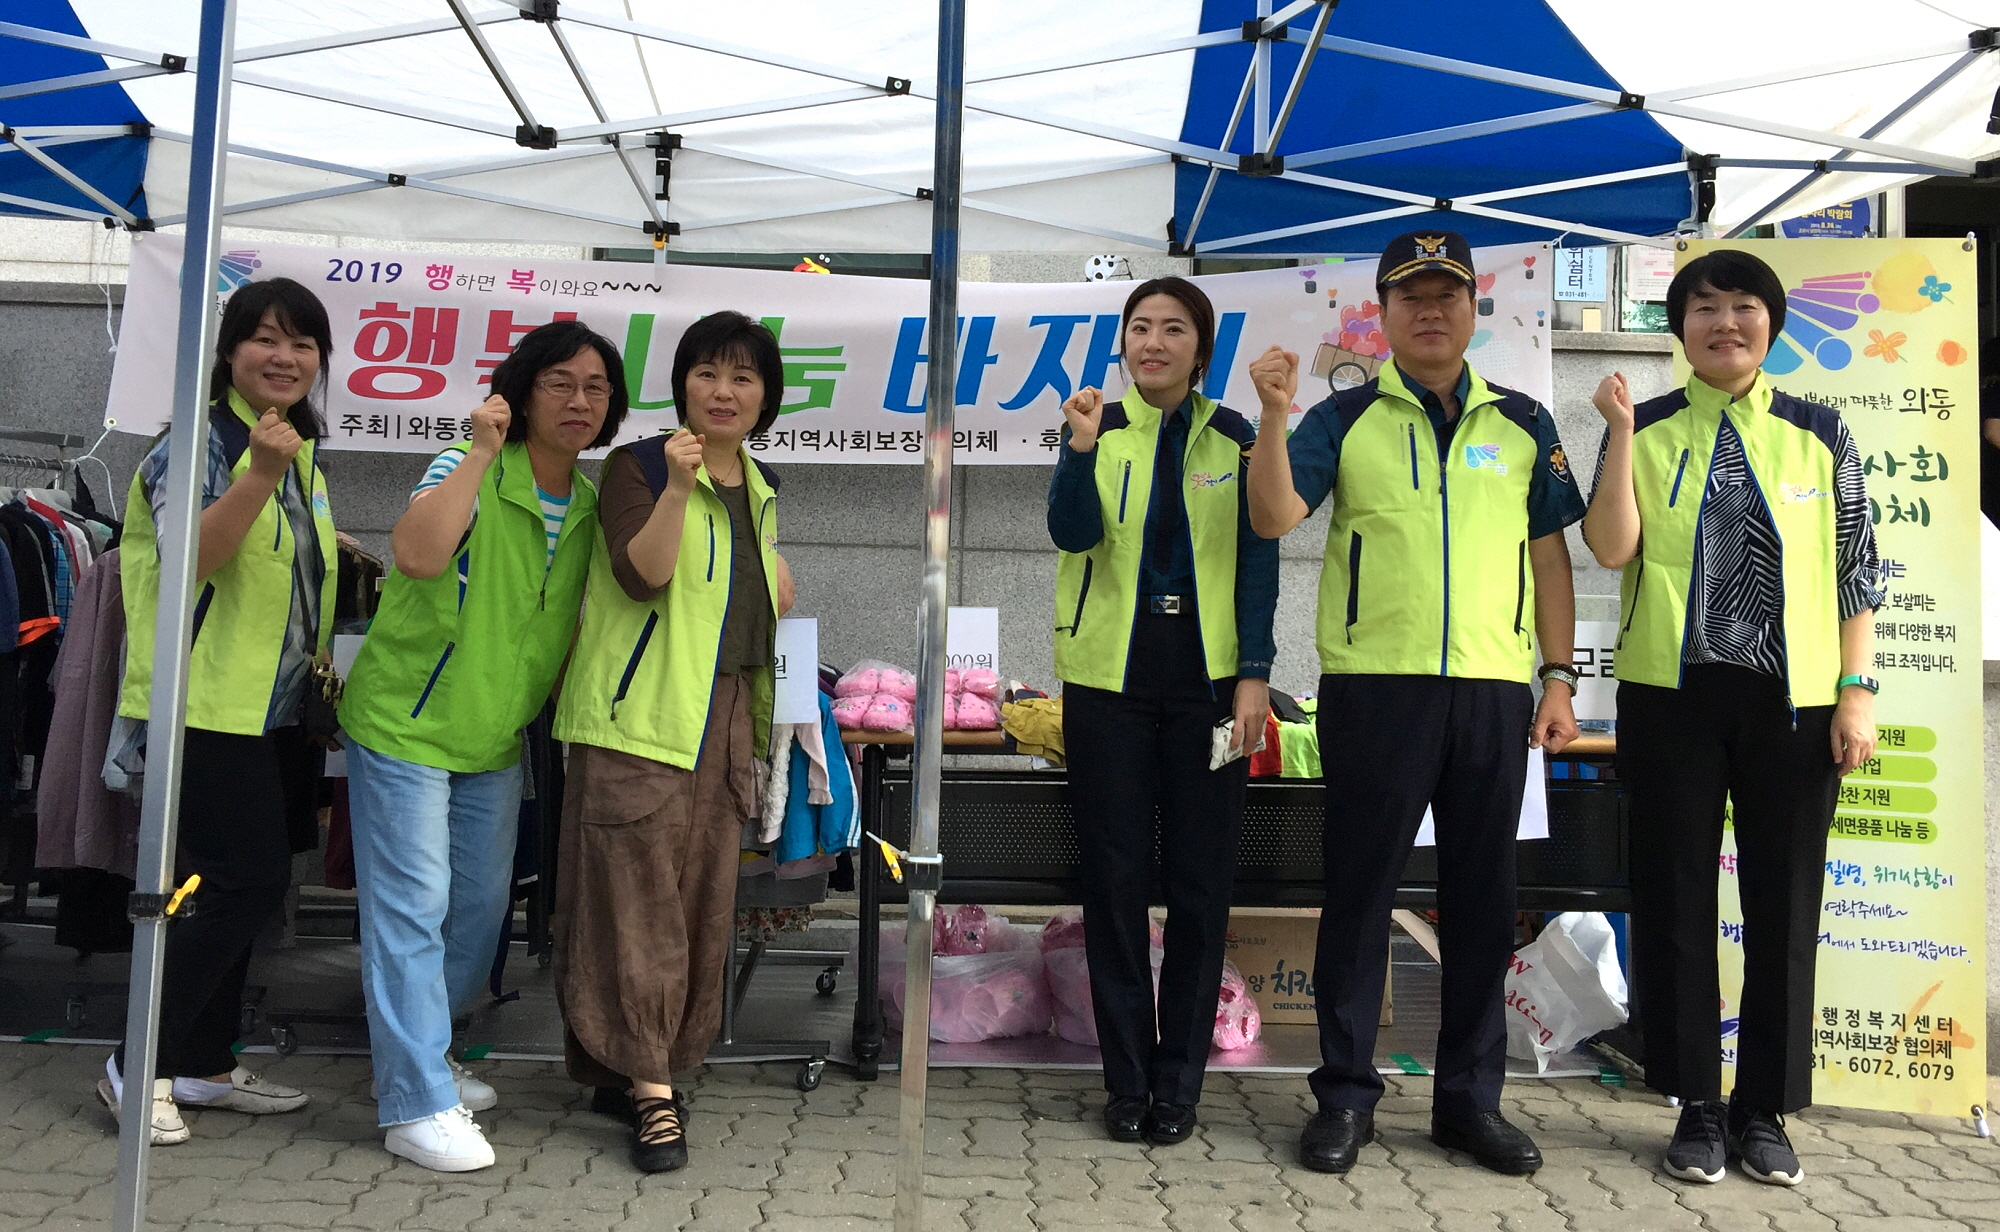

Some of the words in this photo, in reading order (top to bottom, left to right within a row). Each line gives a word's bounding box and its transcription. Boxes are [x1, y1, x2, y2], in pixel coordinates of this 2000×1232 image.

[1827, 209, 1853, 220] 박람회
[326, 258, 403, 284] 2019
[425, 263, 496, 293] 행하면
[882, 311, 1247, 415] 바자
[1850, 393, 1893, 411] 따뜻한
[1899, 387, 1956, 421] 와동
[339, 414, 389, 438] 주최
[1892, 593, 1936, 612] 보살피는
[1875, 621, 1897, 640] 위해
[1899, 623, 1932, 642] 다양한
[1934, 624, 1956, 643] 복지
[1873, 651, 1897, 669] 워크
[1898, 653, 1957, 673] 조직입니다.
[1878, 728, 1906, 747] 지원
[1862, 788, 1890, 806] 지원
[1830, 816, 1883, 837] 세면용품
[1886, 820, 1913, 838] 나눔
[1915, 822, 1930, 840] 등
[1873, 865, 1953, 889] 위기상황이
[1860, 938, 1971, 964] 도와드리겠습니다.
[1902, 1036, 1952, 1060] 협의체
[1848, 1056, 1901, 1079] 6072,
[1908, 1061, 1955, 1081] 6079
